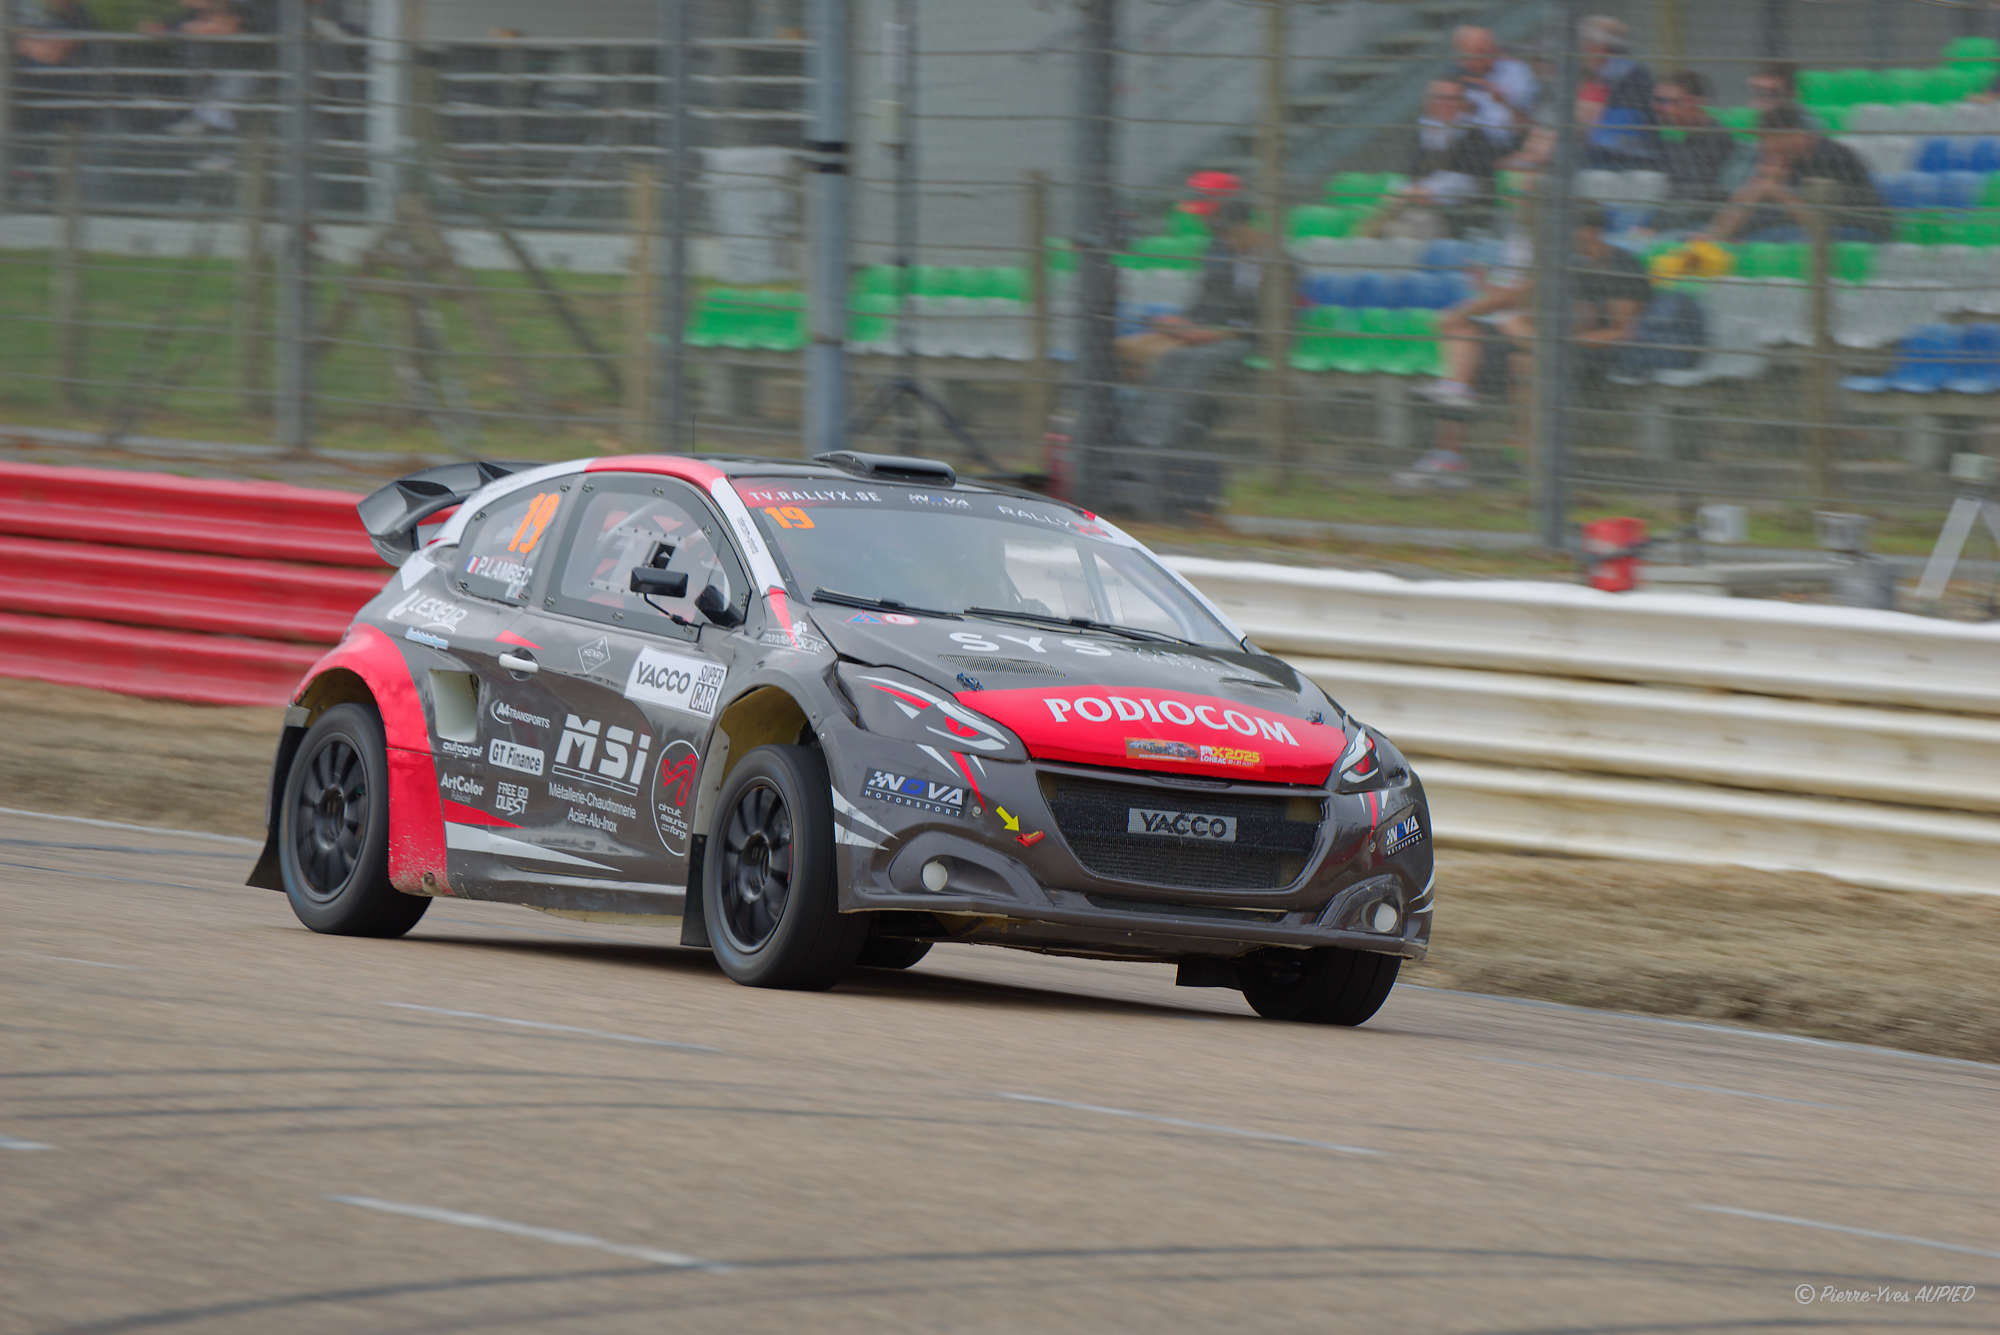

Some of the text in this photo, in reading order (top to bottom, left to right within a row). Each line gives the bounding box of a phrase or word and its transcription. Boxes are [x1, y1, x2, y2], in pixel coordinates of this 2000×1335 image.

[507, 493, 560, 553] 19
[764, 506, 815, 529] 19
[949, 632, 1112, 656] SYS
[636, 661, 691, 694] YACCO
[698, 665, 725, 687] SUPER
[691, 684, 716, 713] CAR
[1043, 696, 1299, 746] PODIOCOM
[493, 743, 541, 772] GT Finance
[440, 772, 484, 796] ArtColor
[498, 781, 518, 797] FREE
[870, 771, 963, 806] NOVA
[496, 794, 528, 815] OUEST
[864, 788, 960, 817] MOTORSPORT
[1140, 812, 1227, 838] YACCO
[1387, 815, 1420, 846] NOVA
